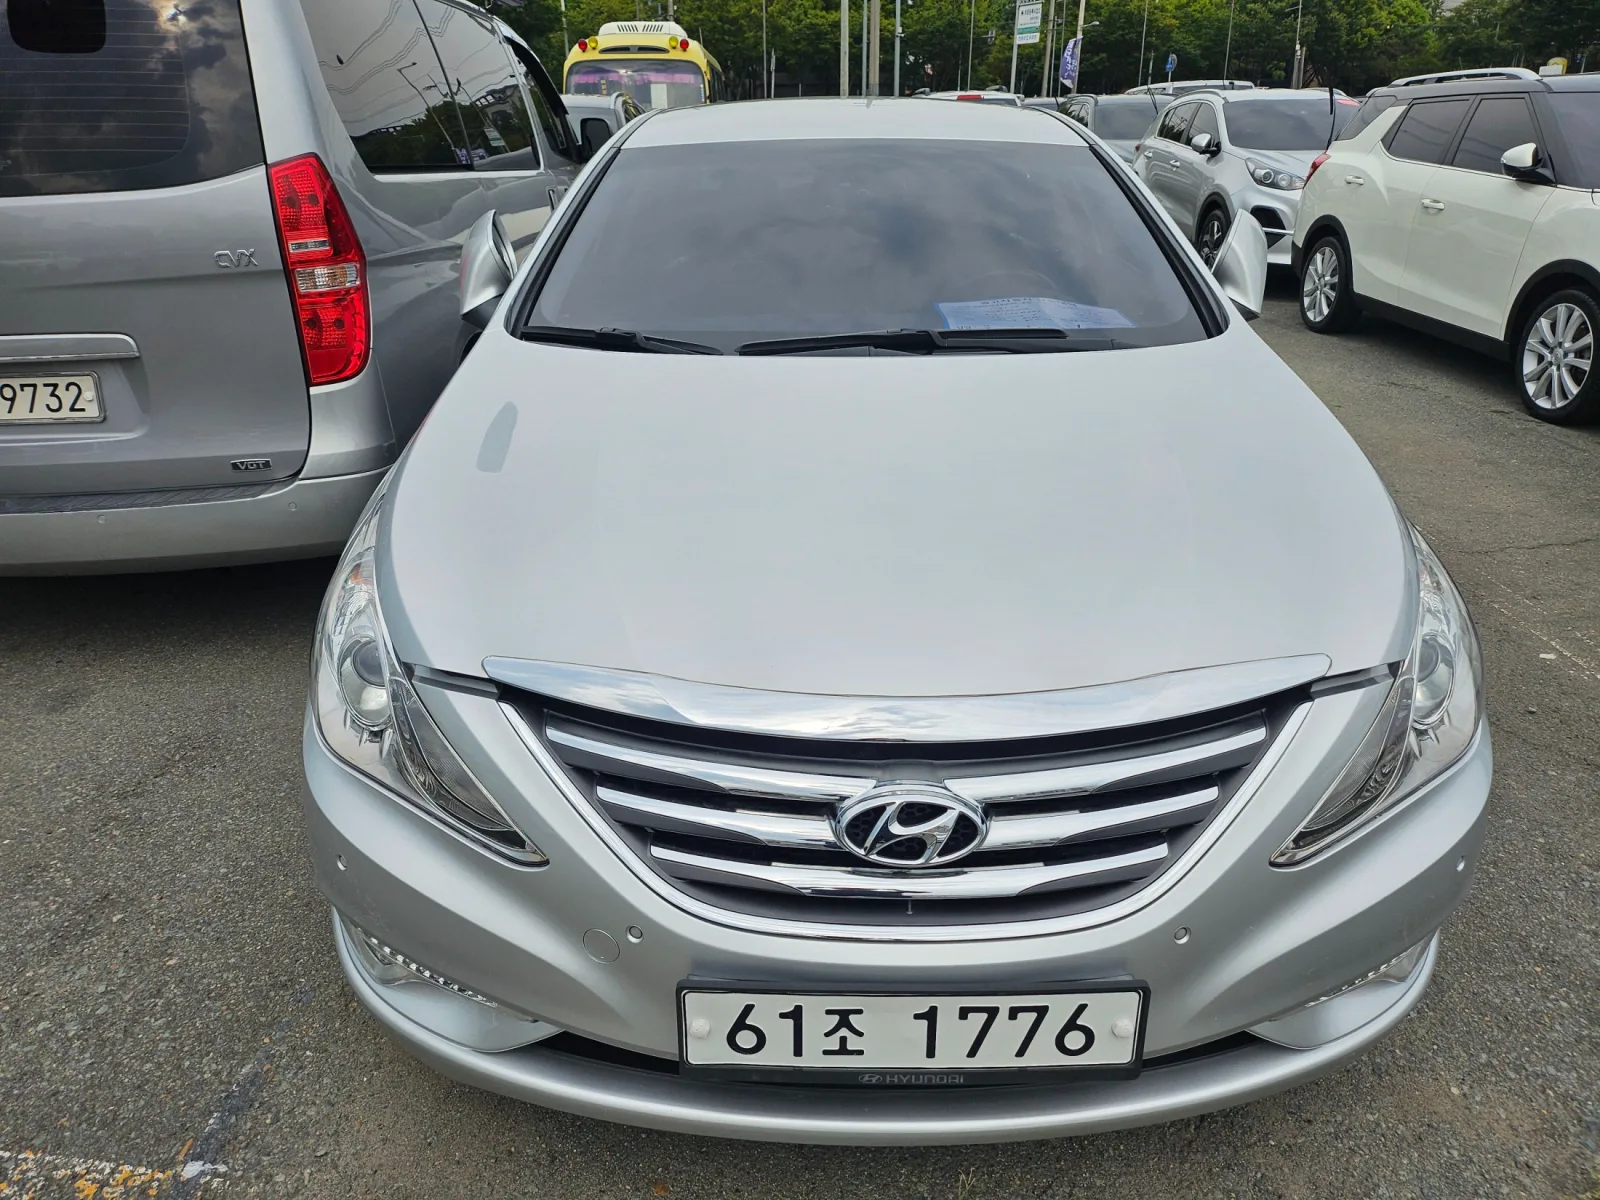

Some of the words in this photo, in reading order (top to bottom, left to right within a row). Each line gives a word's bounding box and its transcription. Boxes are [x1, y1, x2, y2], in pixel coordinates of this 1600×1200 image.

[213, 248, 259, 268] CVX
[0, 381, 86, 414] 9732
[236, 460, 266, 470] VGT
[726, 1003, 865, 1058] 61조
[913, 1003, 1096, 1059] 1776
[886, 1074, 964, 1084] HYUNDAI
